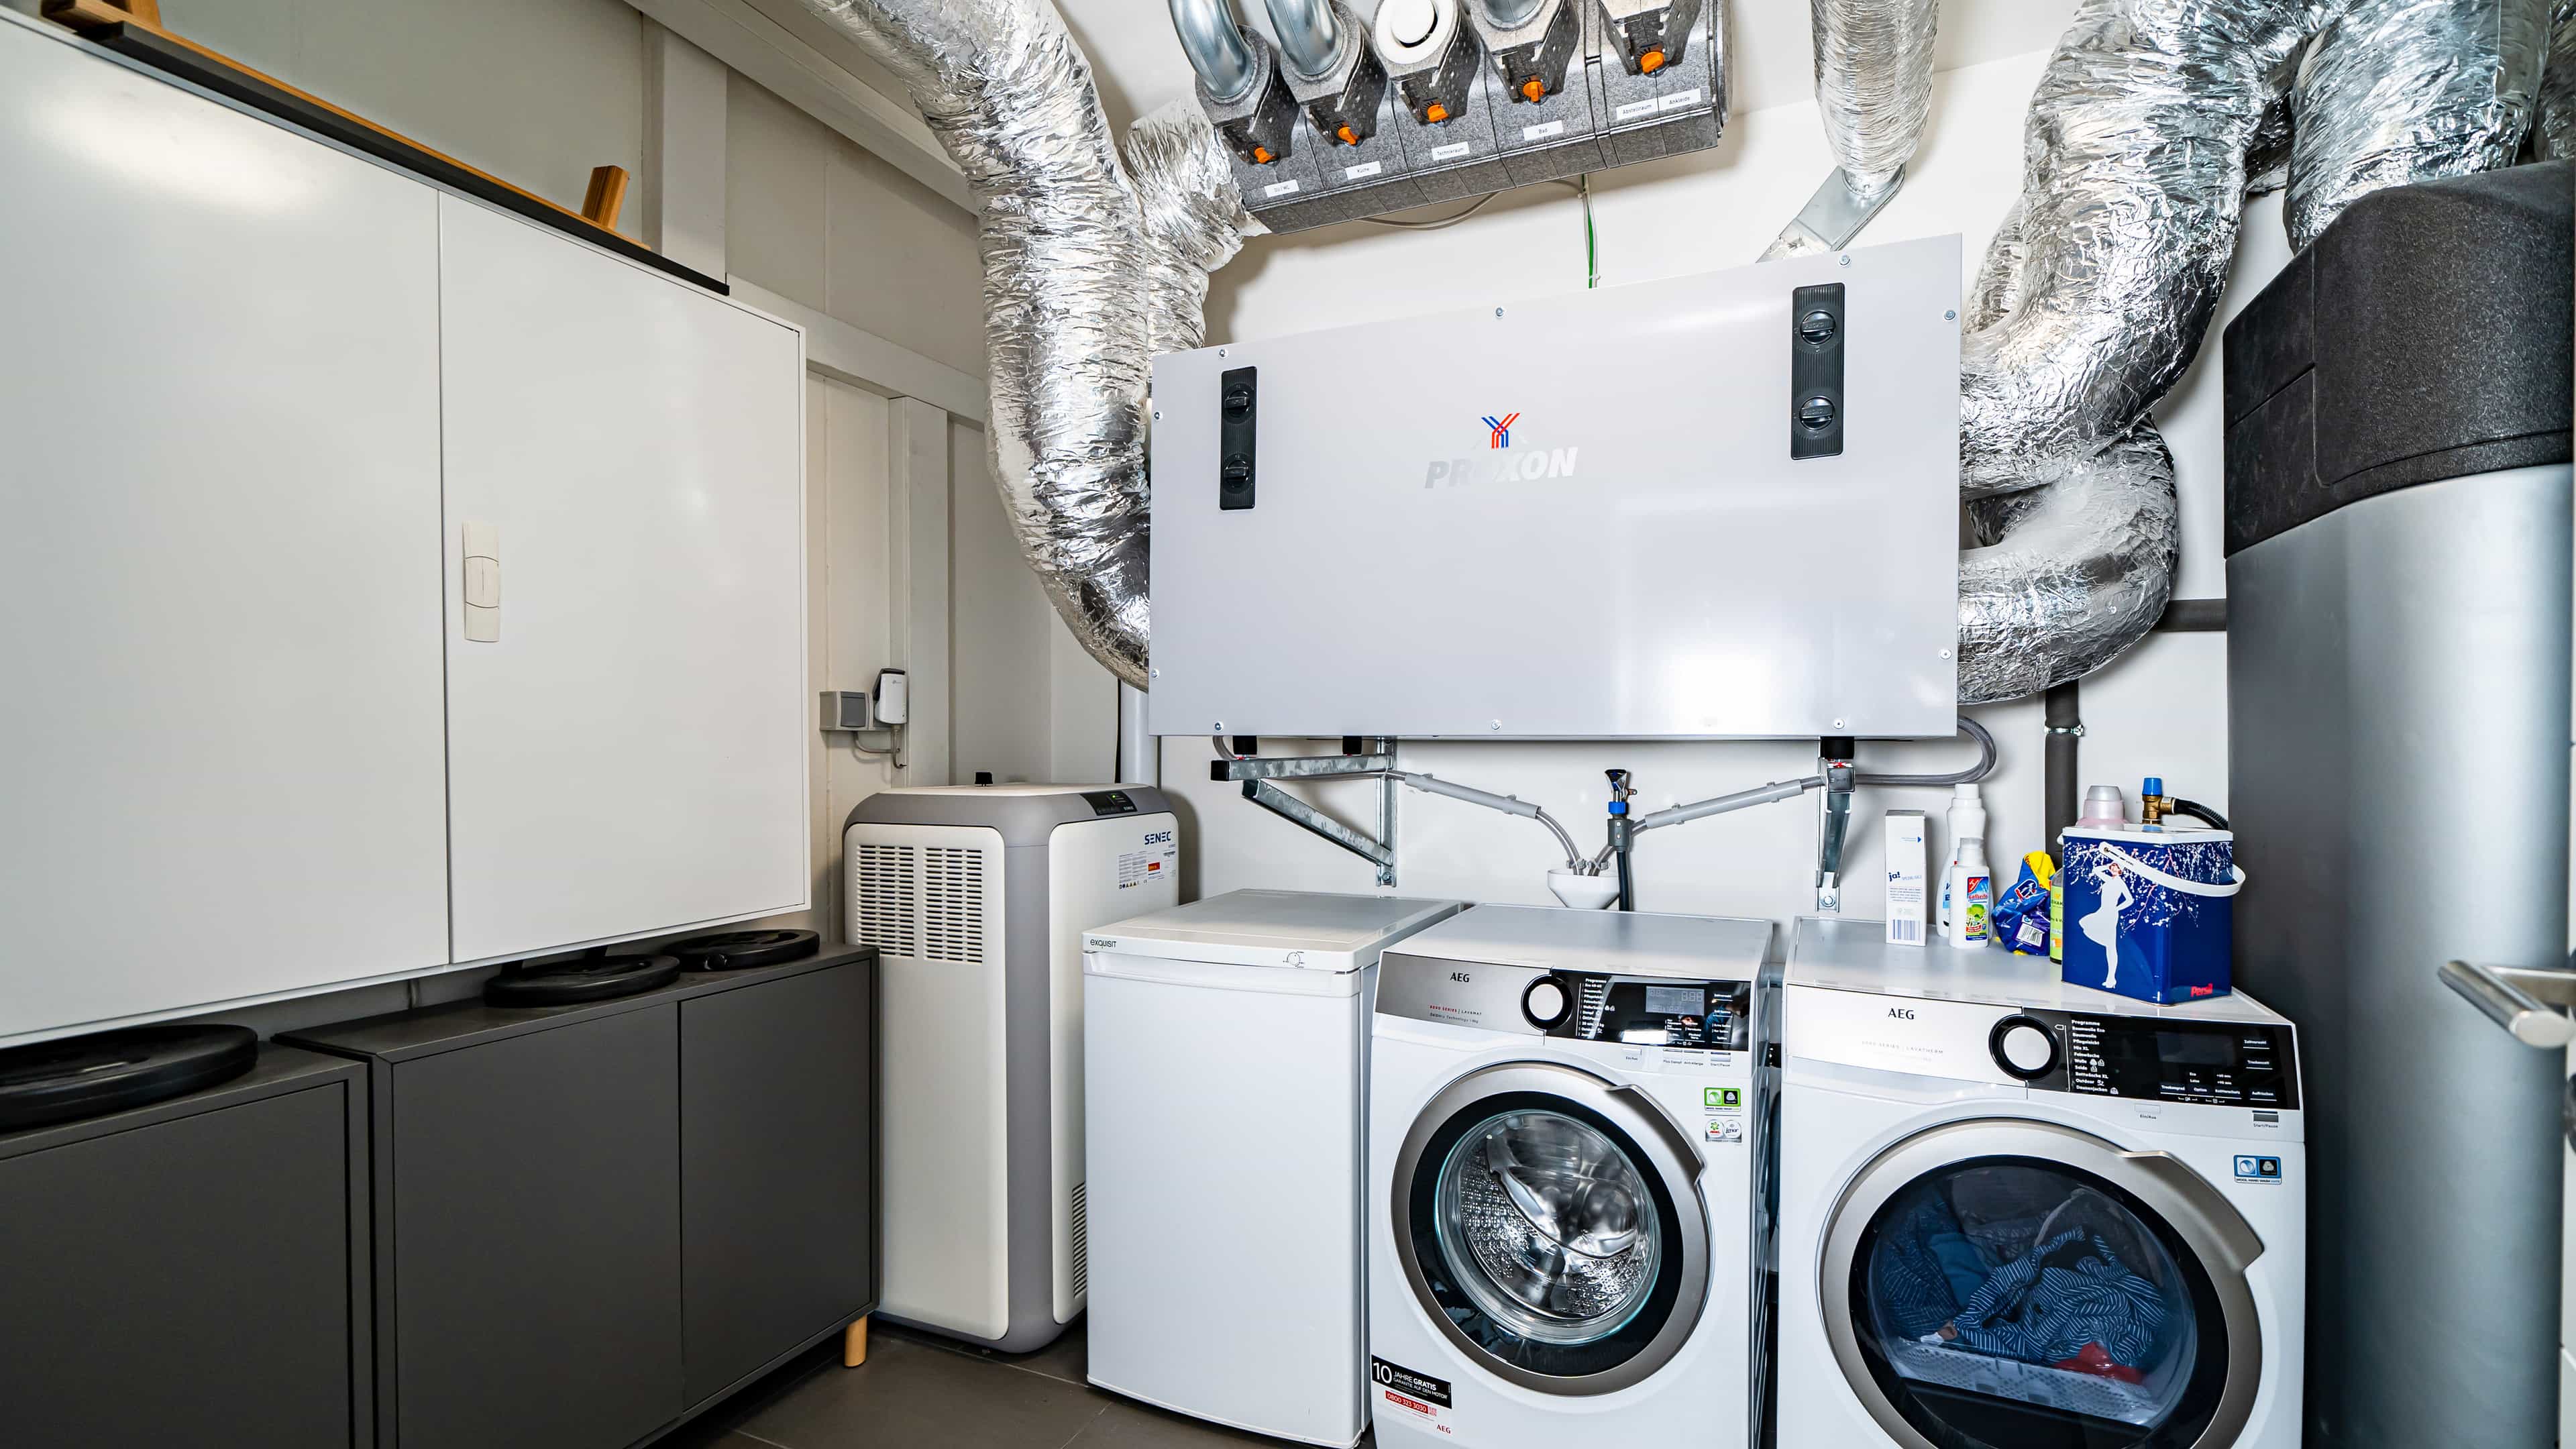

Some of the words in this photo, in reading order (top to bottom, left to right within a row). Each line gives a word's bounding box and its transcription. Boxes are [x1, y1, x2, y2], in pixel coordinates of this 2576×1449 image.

[1670, 95, 1690, 105] Ankleide
[1622, 104, 1652, 115] Abstellraum
[1436, 146, 1464, 156] Technikraum
[1144, 831, 1172, 845] SENEC
[1888, 871, 1900, 882] ja!
[1450, 972, 1470, 983] AEG
[2190, 982, 2214, 998] Persil
[1888, 1007, 1915, 1020] AEG
[1373, 1362, 1393, 1384] 10
[1393, 1371, 1413, 1383] JAHRE
[1413, 1378, 1437, 1391] GRATIS
[1432, 1391, 1448, 1400] MOTOR
[1387, 1393, 1401, 1403] 0800
[1402, 1399, 1412, 1407] 323
[1412, 1402, 1427, 1413] 3030
[1436, 1424, 1452, 1434] AEG
